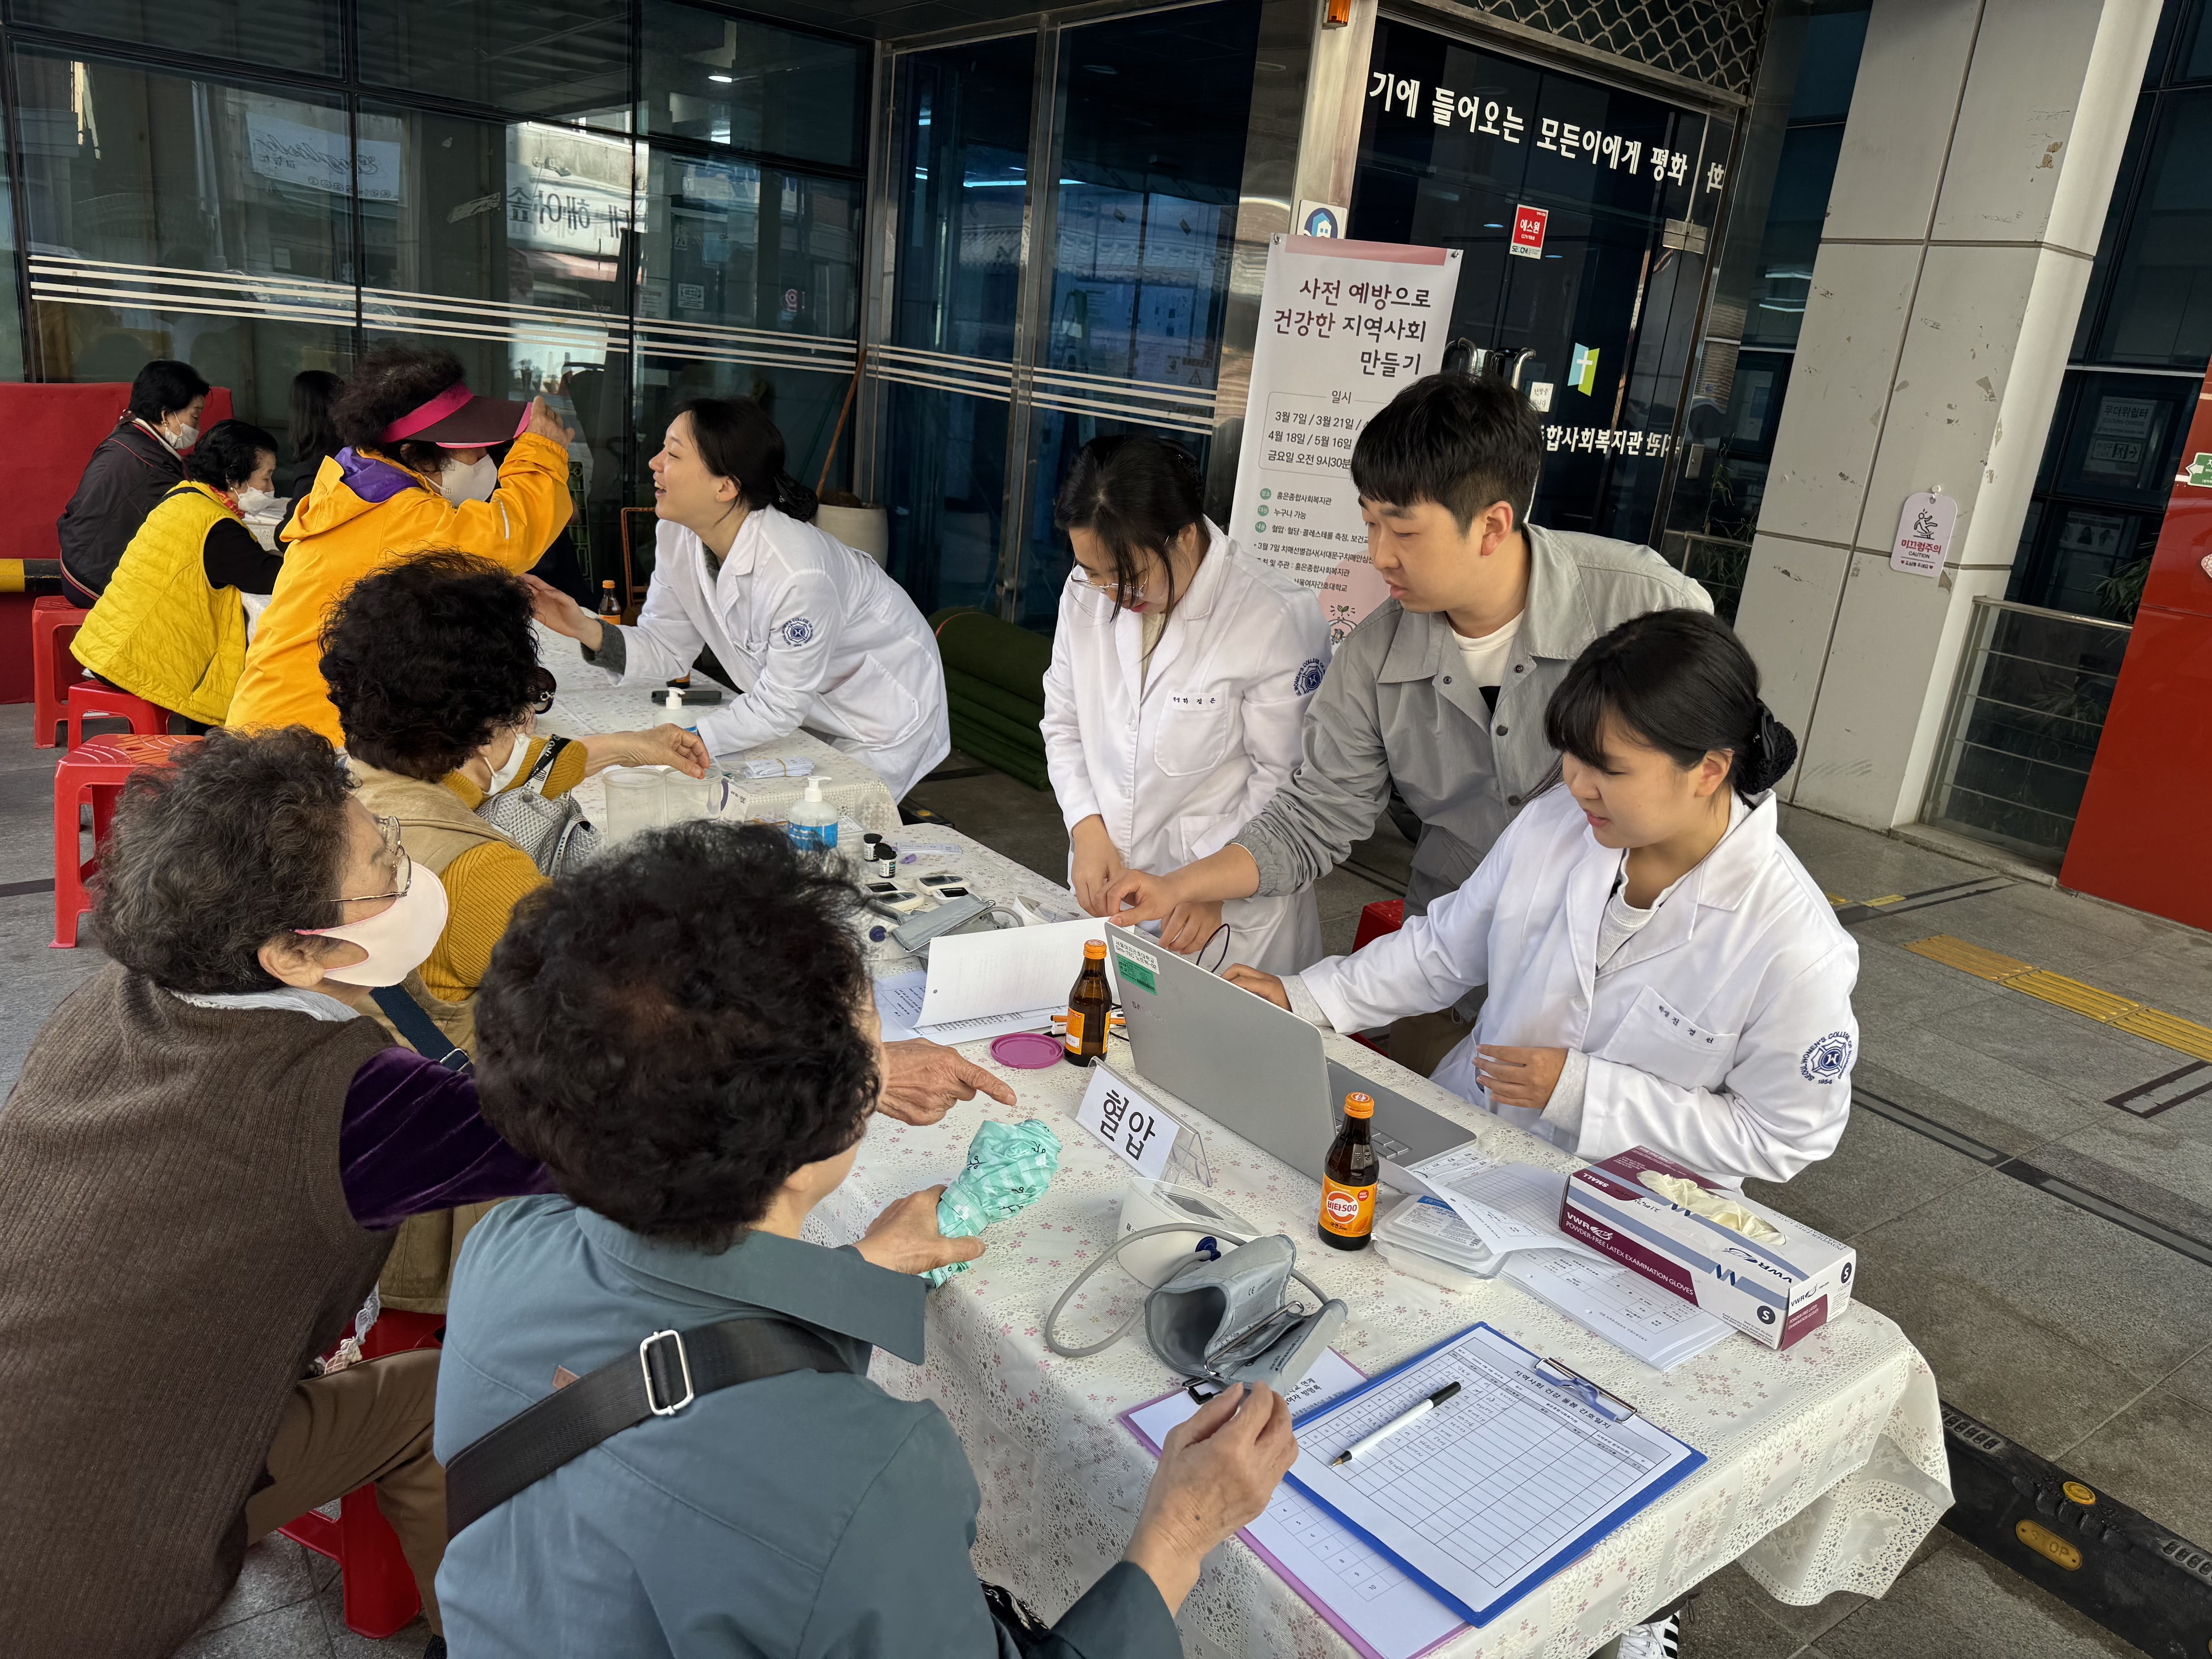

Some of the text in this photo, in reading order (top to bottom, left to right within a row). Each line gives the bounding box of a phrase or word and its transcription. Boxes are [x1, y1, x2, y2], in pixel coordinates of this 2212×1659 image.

[1370, 72, 1687, 185] 기에 들어오는 모든이에게 평화
[1520, 219, 1540, 234] 에스원
[1299, 278, 1431, 311] 사전 예방으로
[1274, 309, 1427, 343] 건강한 지역사회
[1360, 350, 1421, 378] 만들기
[1331, 390, 1352, 405] 일시
[1275, 411, 1290, 423] 3월
[1293, 413, 1307, 424] 7일
[1316, 416, 1331, 427] 3월
[1333, 417, 1354, 429] 21일
[2104, 405, 2148, 419] 무더위쉼터
[1268, 431, 1283, 442] 4월
[1286, 433, 1305, 445] 18일
[1315, 436, 1329, 447] 5월
[1333, 438, 1352, 450] 16일
[1541, 425, 1643, 455] 합사회복지관
[1268, 450, 1352, 469] 금요일 오전 9시30분
[1274, 508, 1293, 518] 누구나
[1294, 510, 1306, 520] 가능
[1901, 539, 1942, 555] 미끄럼주의
[1277, 560, 1290, 569] 주관
[1099, 1089, 1156, 1161] 혈압
[1583, 1173, 1609, 1188] SMALL
[1327, 1200, 1357, 1212] 비타500
[1566, 1211, 1590, 1231] VWR
[1566, 1220, 1606, 1248] POWDER-FREE
[1607, 1243, 1625, 1258] LATEX
[1625, 1254, 1668, 1282] EXAMINATION
[1669, 1278, 1693, 1295] GLOVES
[1758, 1262, 1792, 1283] VWR
[1844, 1267, 1850, 1279] S
[1791, 1295, 1805, 1307] VWR
[1762, 1310, 1770, 1320] S
[1301, 1384, 1322, 1395] 방명록
[1513, 1370, 1544, 1389] 지역사회
[1545, 1388, 1561, 1402] 건강
[1580, 1407, 1611, 1429] 간호일지
[2029, 1529, 2070, 1558] STOP
